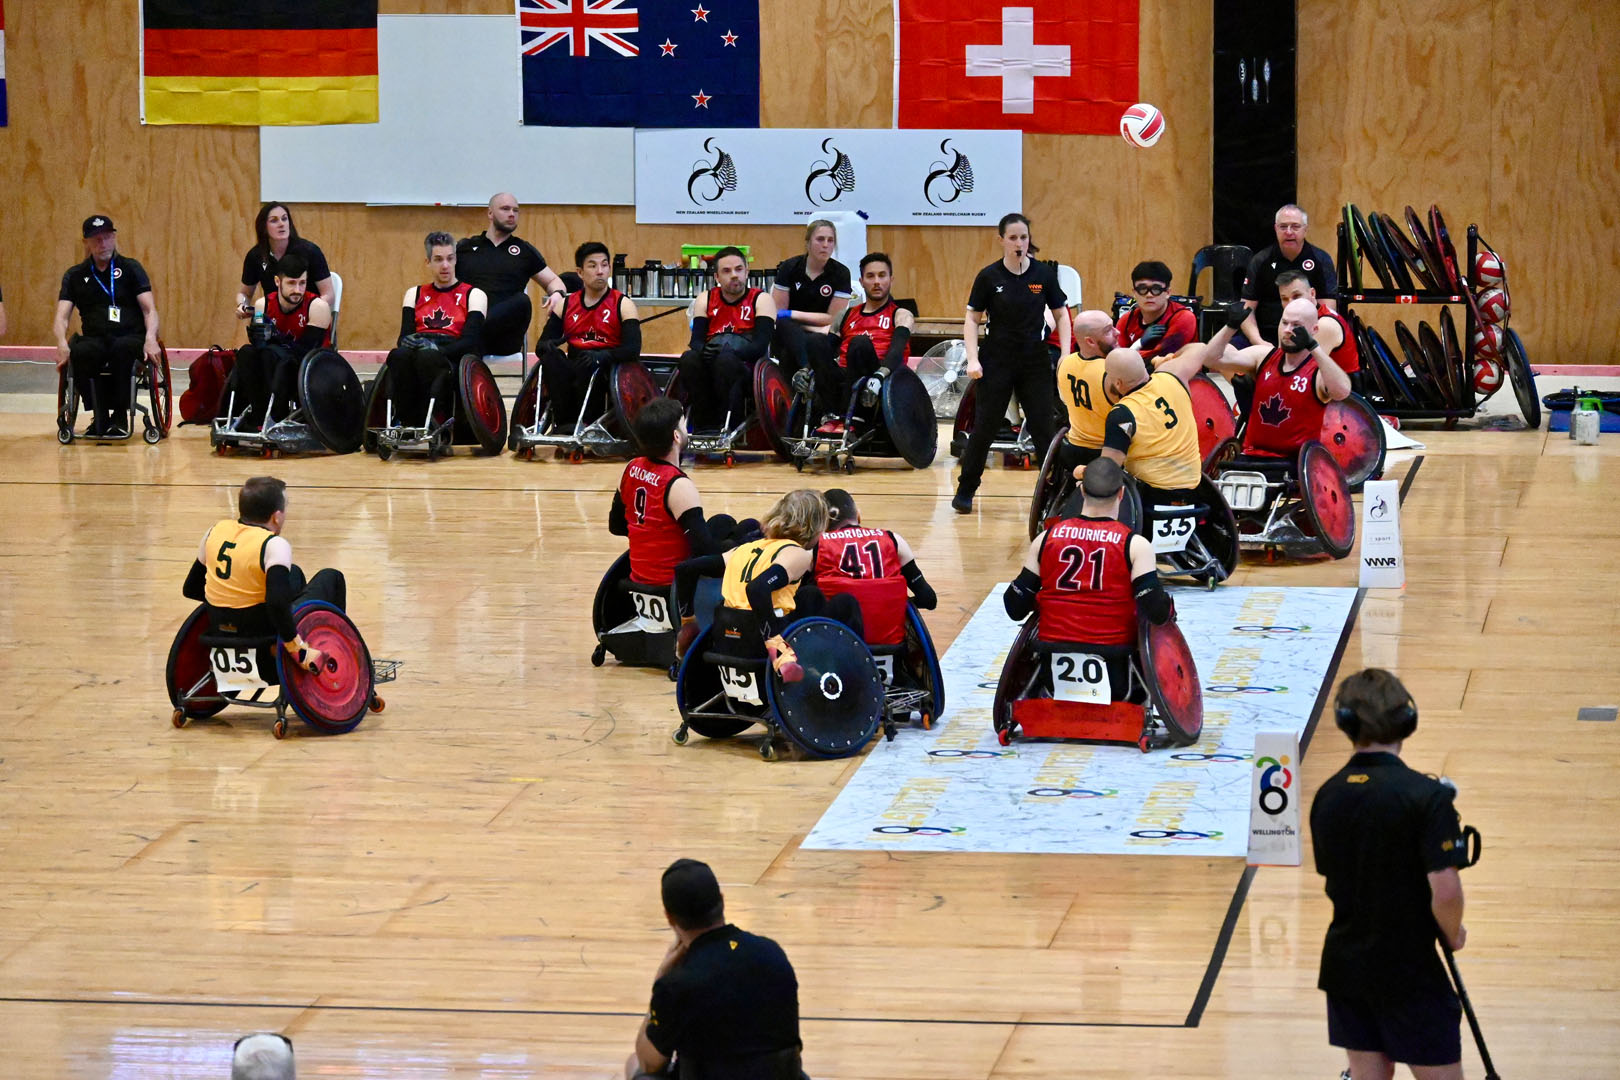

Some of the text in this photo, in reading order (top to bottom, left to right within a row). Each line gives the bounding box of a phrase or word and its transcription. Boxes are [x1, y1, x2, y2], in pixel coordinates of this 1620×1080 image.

[455, 292, 463, 306] 7
[602, 309, 611, 324] 2
[739, 305, 751, 321] 12
[878, 314, 890, 329] 10
[1066, 374, 1092, 410] 10
[1290, 375, 1308, 393] 33
[1155, 396, 1178, 430] 3
[634, 486, 647, 525] 9
[822, 528, 884, 540] RODRIGUES
[1052, 525, 1122, 544] LÉTOURNEAU
[1157, 517, 1192, 537] 3.5
[216, 540, 237, 580] 5
[839, 540, 884, 579] 41
[1056, 545, 1106, 591] 21
[636, 594, 664, 622] 2.0
[214, 647, 252, 674] 0.5
[1056, 656, 1103, 684] 2.0
[1252, 828, 1295, 836] WELLINGTON
